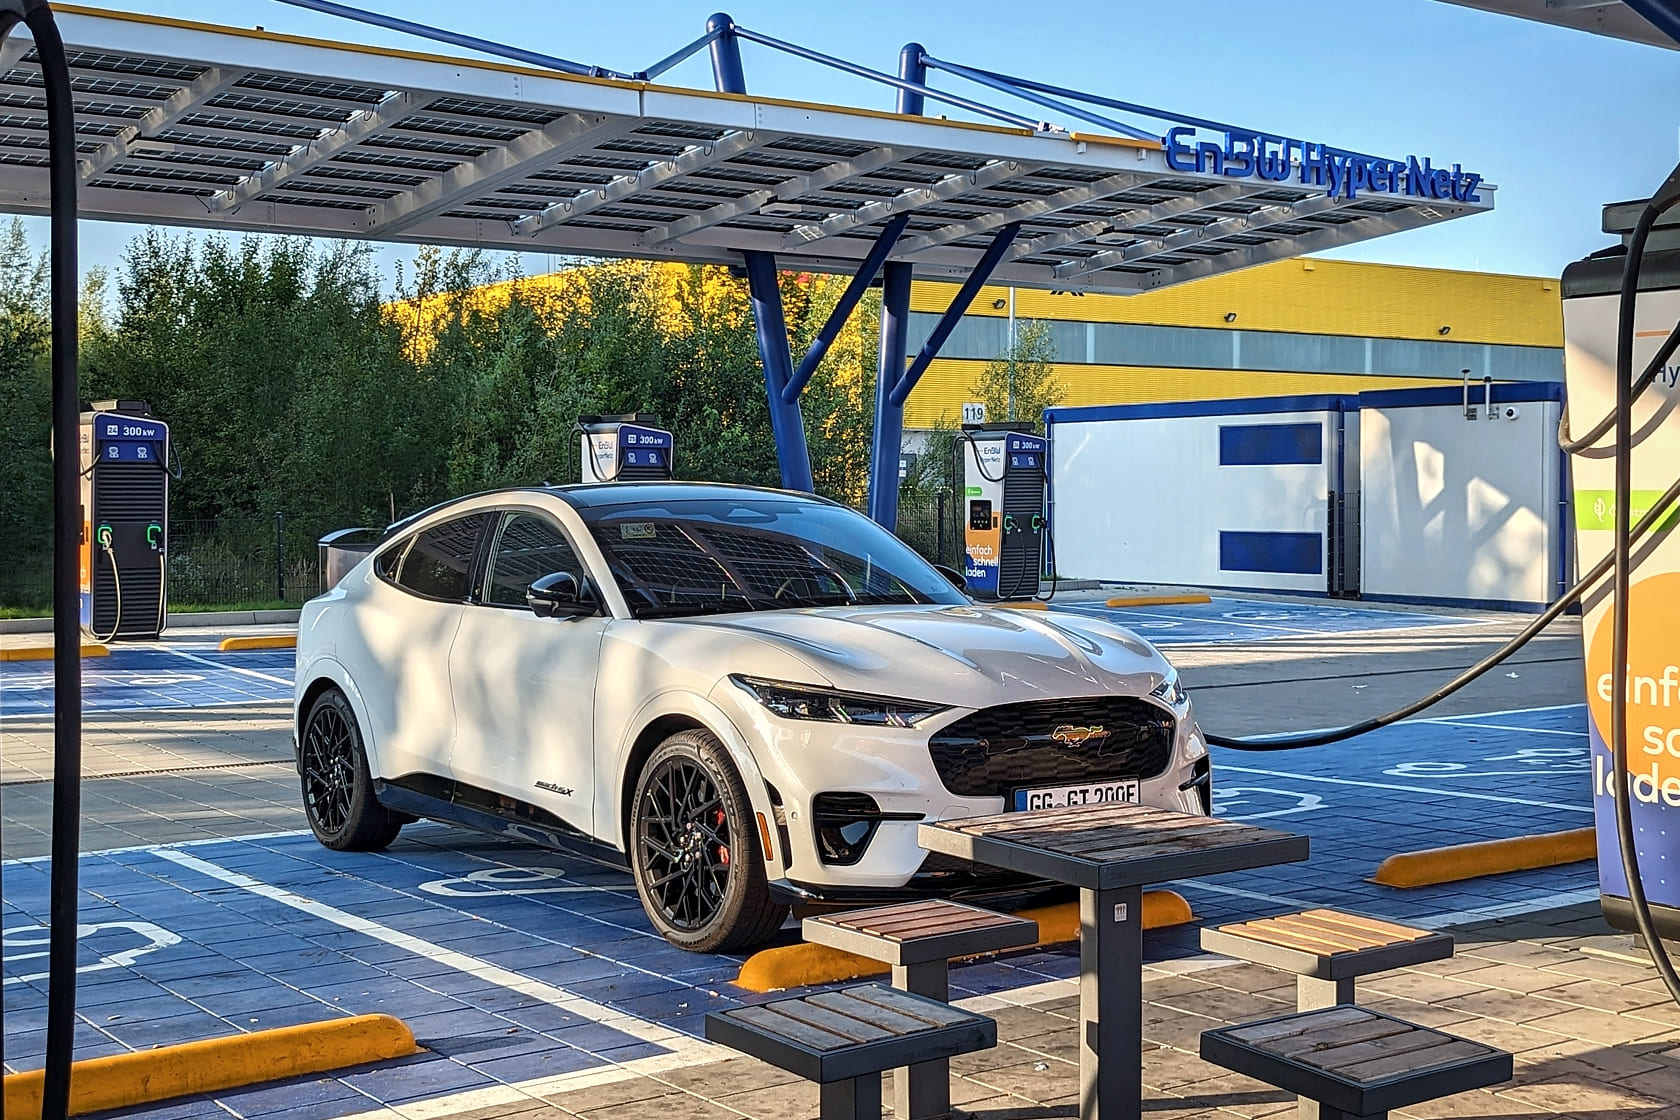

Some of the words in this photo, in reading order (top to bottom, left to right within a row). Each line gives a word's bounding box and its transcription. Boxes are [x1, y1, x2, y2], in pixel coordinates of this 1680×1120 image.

[1165, 126, 1291, 182] EnBW
[1300, 141, 1485, 202] HyperNetz
[965, 407, 983, 420] 119
[123, 426, 142, 436] 300
[640, 436, 654, 445] 300
[965, 544, 993, 555] einfach
[973, 556, 998, 567] schnell
[965, 566, 986, 578] laden
[1597, 663, 1680, 707] einf
[1030, 793, 1052, 810] GG
[1067, 789, 1089, 806] GT
